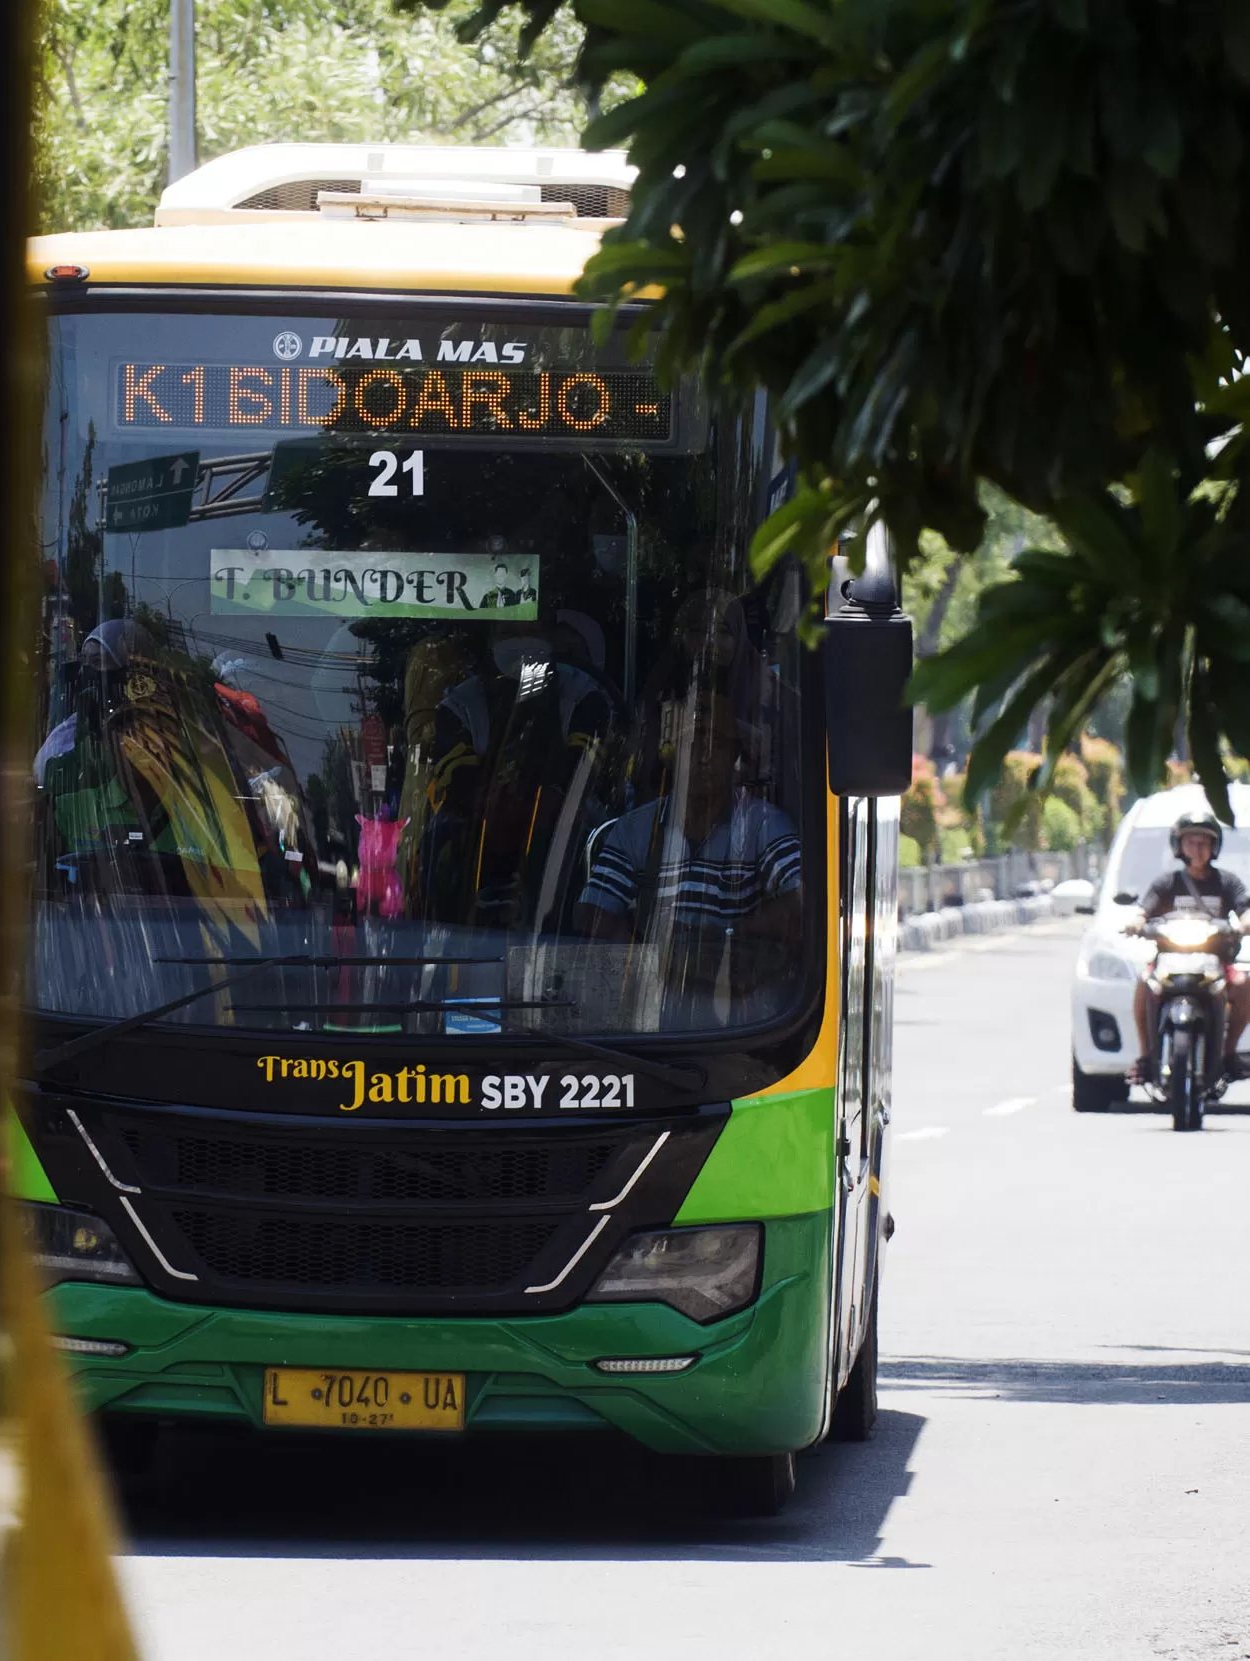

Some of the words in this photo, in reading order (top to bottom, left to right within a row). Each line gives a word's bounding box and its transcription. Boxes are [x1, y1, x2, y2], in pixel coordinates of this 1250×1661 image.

[308, 336, 422, 360] PIALA
[437, 340, 528, 364] MAS
[367, 450, 424, 497] 21
[214, 566, 250, 601] T.
[263, 567, 477, 610] BUNDER
[257, 1055, 339, 1082] Trans
[340, 1061, 472, 1110] Jatim
[481, 1075, 550, 1109] SBY
[559, 1074, 635, 1109] 2221
[272, 1373, 288, 1405] L
[323, 1375, 388, 1408] 7040
[423, 1377, 458, 1410] UA
